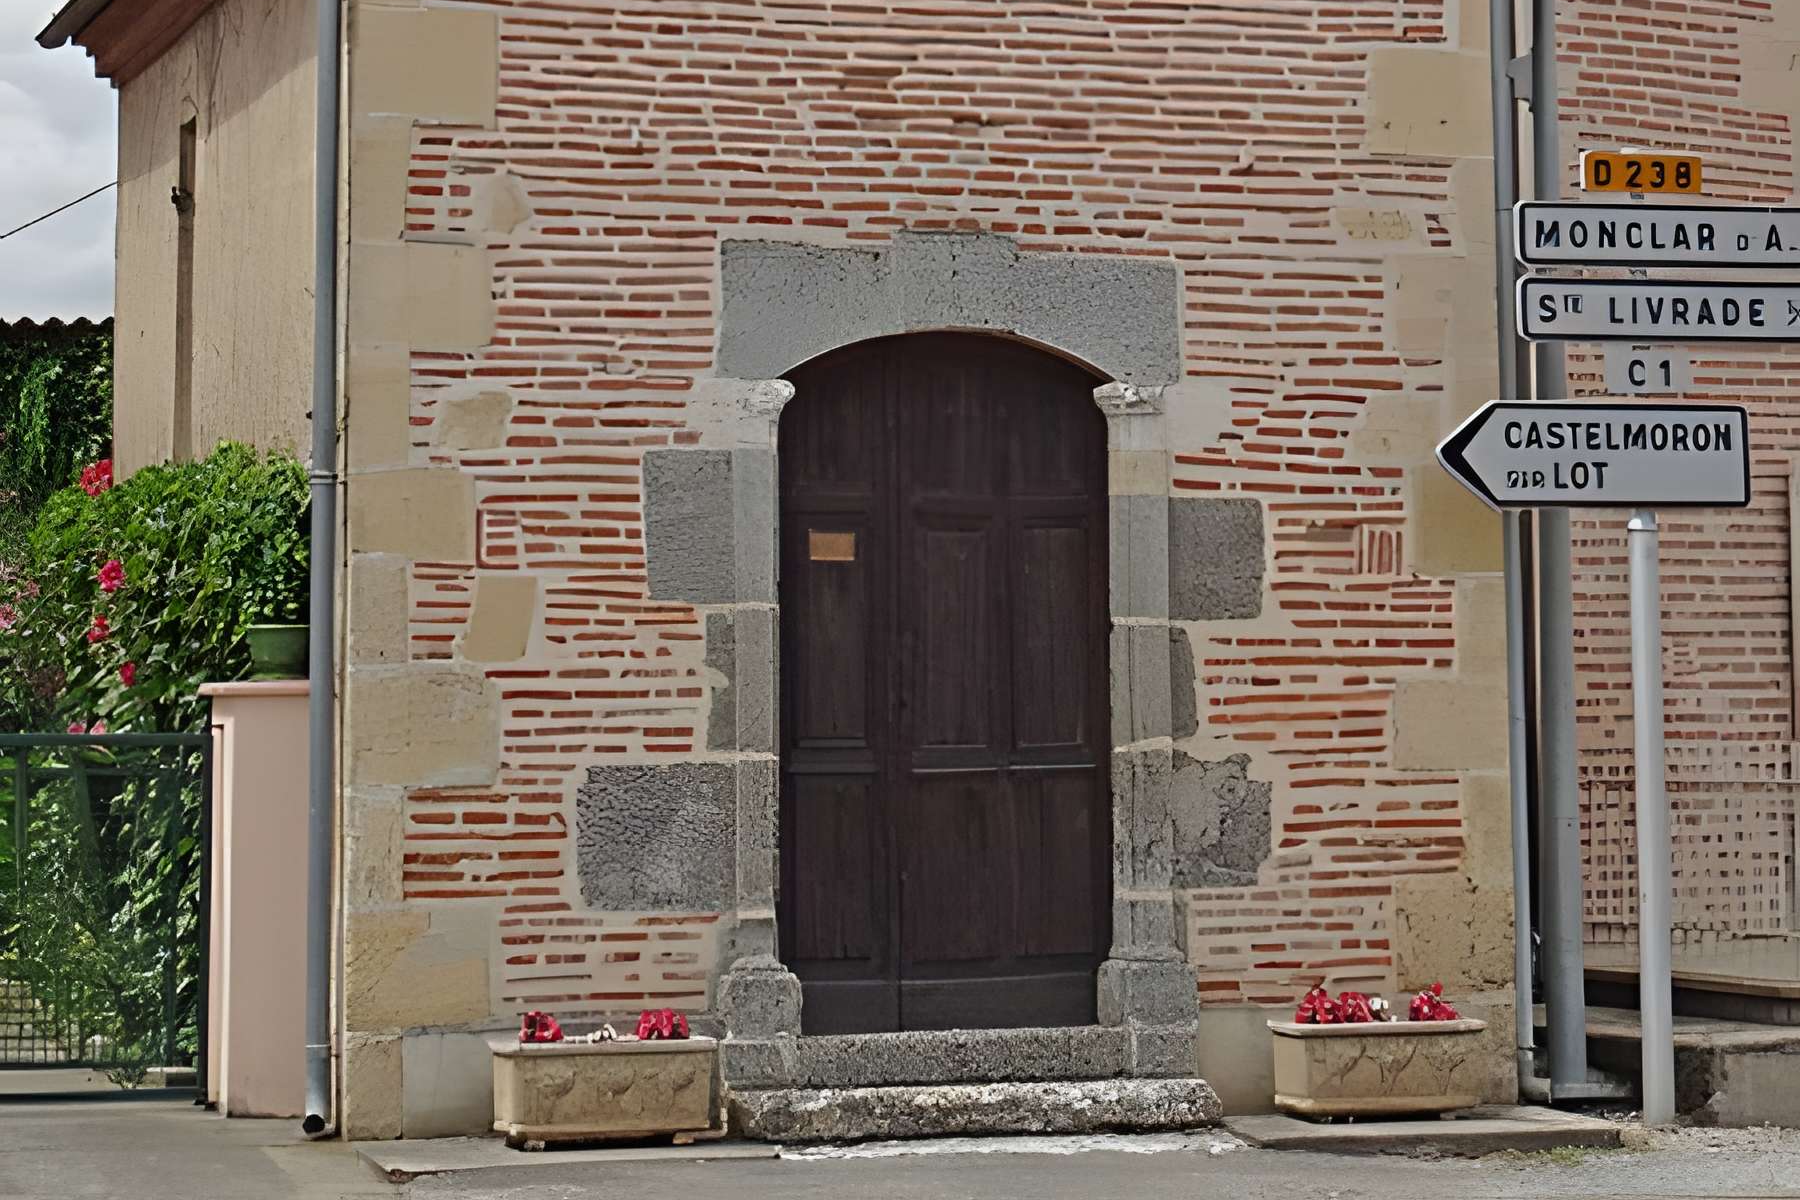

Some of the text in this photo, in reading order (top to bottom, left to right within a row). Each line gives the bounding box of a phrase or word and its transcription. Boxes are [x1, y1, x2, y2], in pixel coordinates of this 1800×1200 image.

[1593, 159, 1692, 189] D 238
[1535, 219, 1715, 252] MONCLAR
[1608, 296, 1765, 327] LIVRADE
[1628, 359, 1671, 388] C 1
[1504, 421, 1732, 452] CASTELMORON
[1553, 461, 1609, 490] LOT
